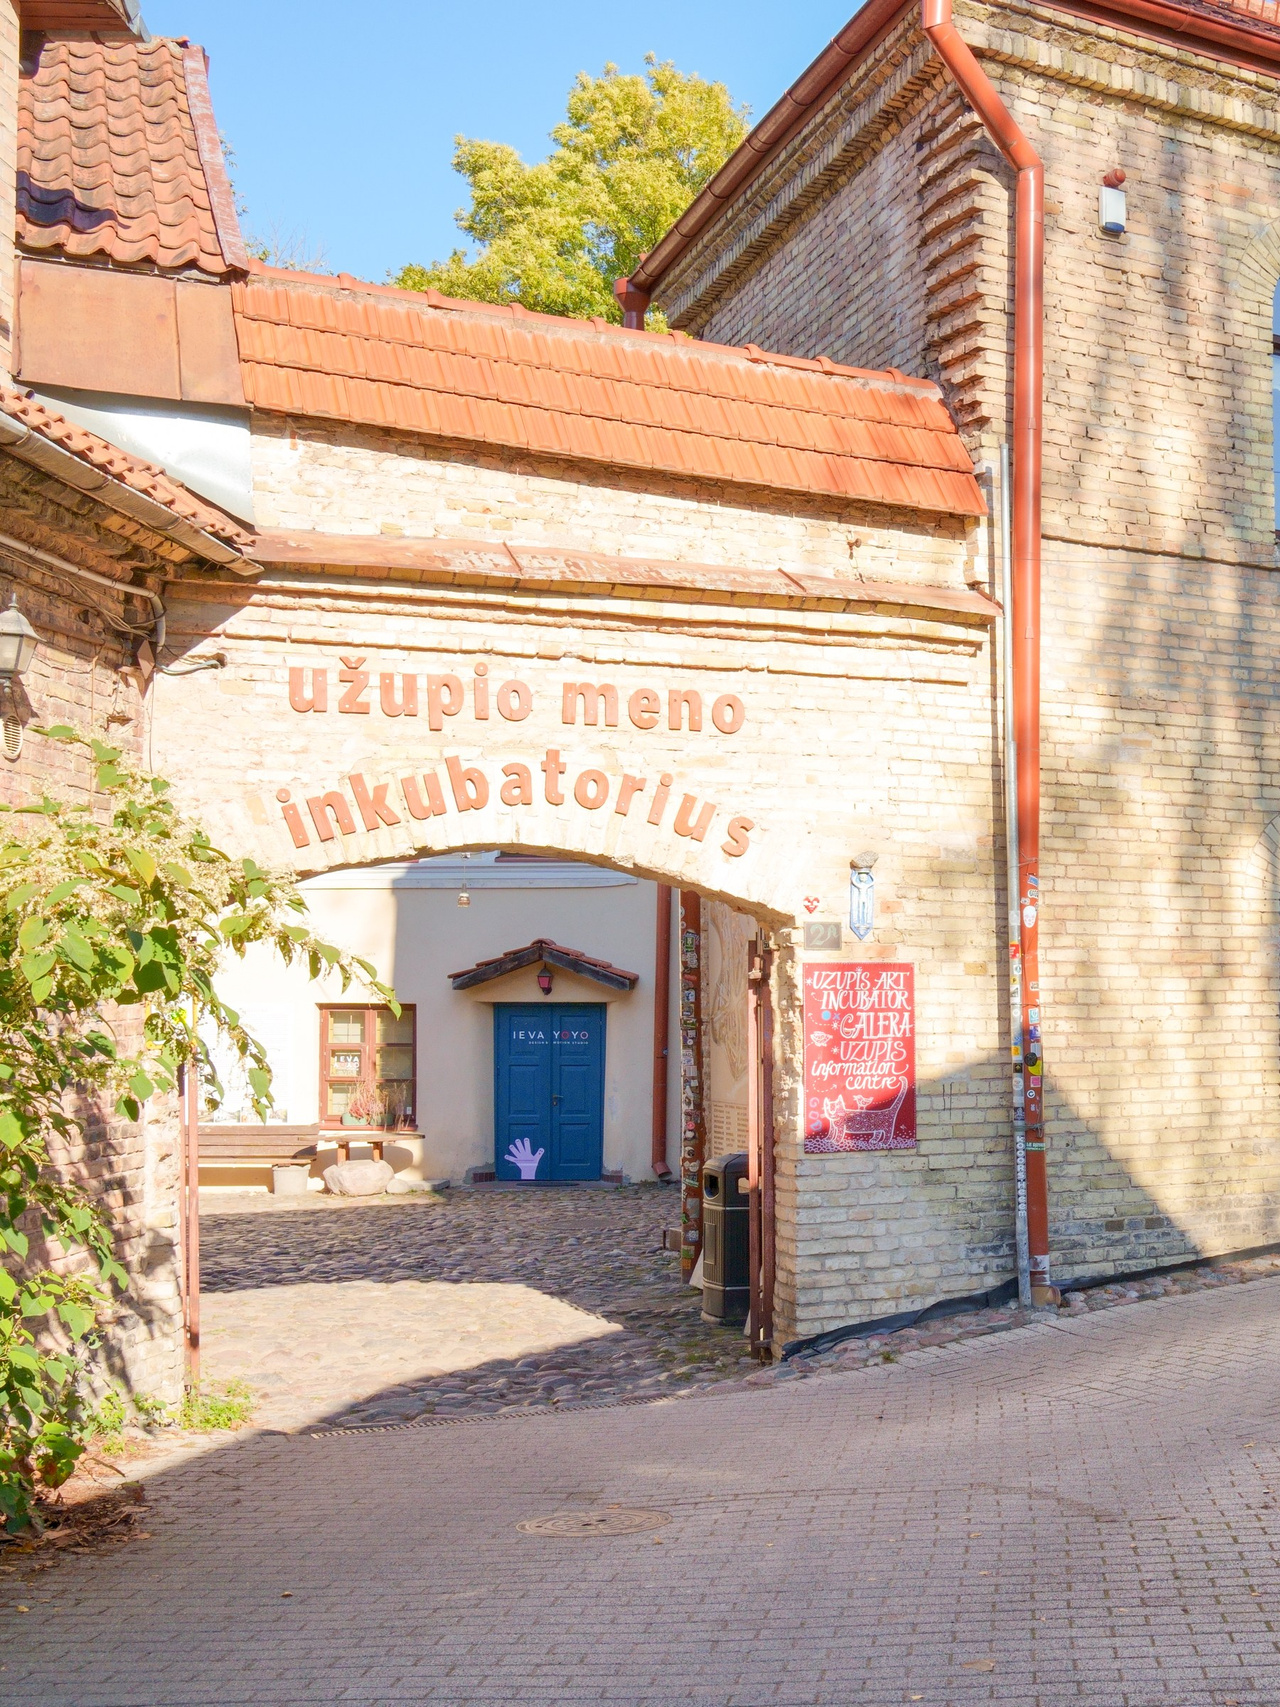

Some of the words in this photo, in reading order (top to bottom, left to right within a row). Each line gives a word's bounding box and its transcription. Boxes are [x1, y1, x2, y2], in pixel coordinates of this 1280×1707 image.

[288, 656, 532, 731] užupio
[562, 681, 745, 734] meno
[276, 749, 756, 857] inkubatorius
[874, 971, 910, 990] ART
[820, 989, 911, 1010] INCUBATOR
[513, 1031, 544, 1039] IEVA
[553, 1030, 589, 1040] YOYO
[840, 1011, 914, 1039] GALERA
[811, 1060, 909, 1081] information
[845, 1076, 901, 1090] centre
